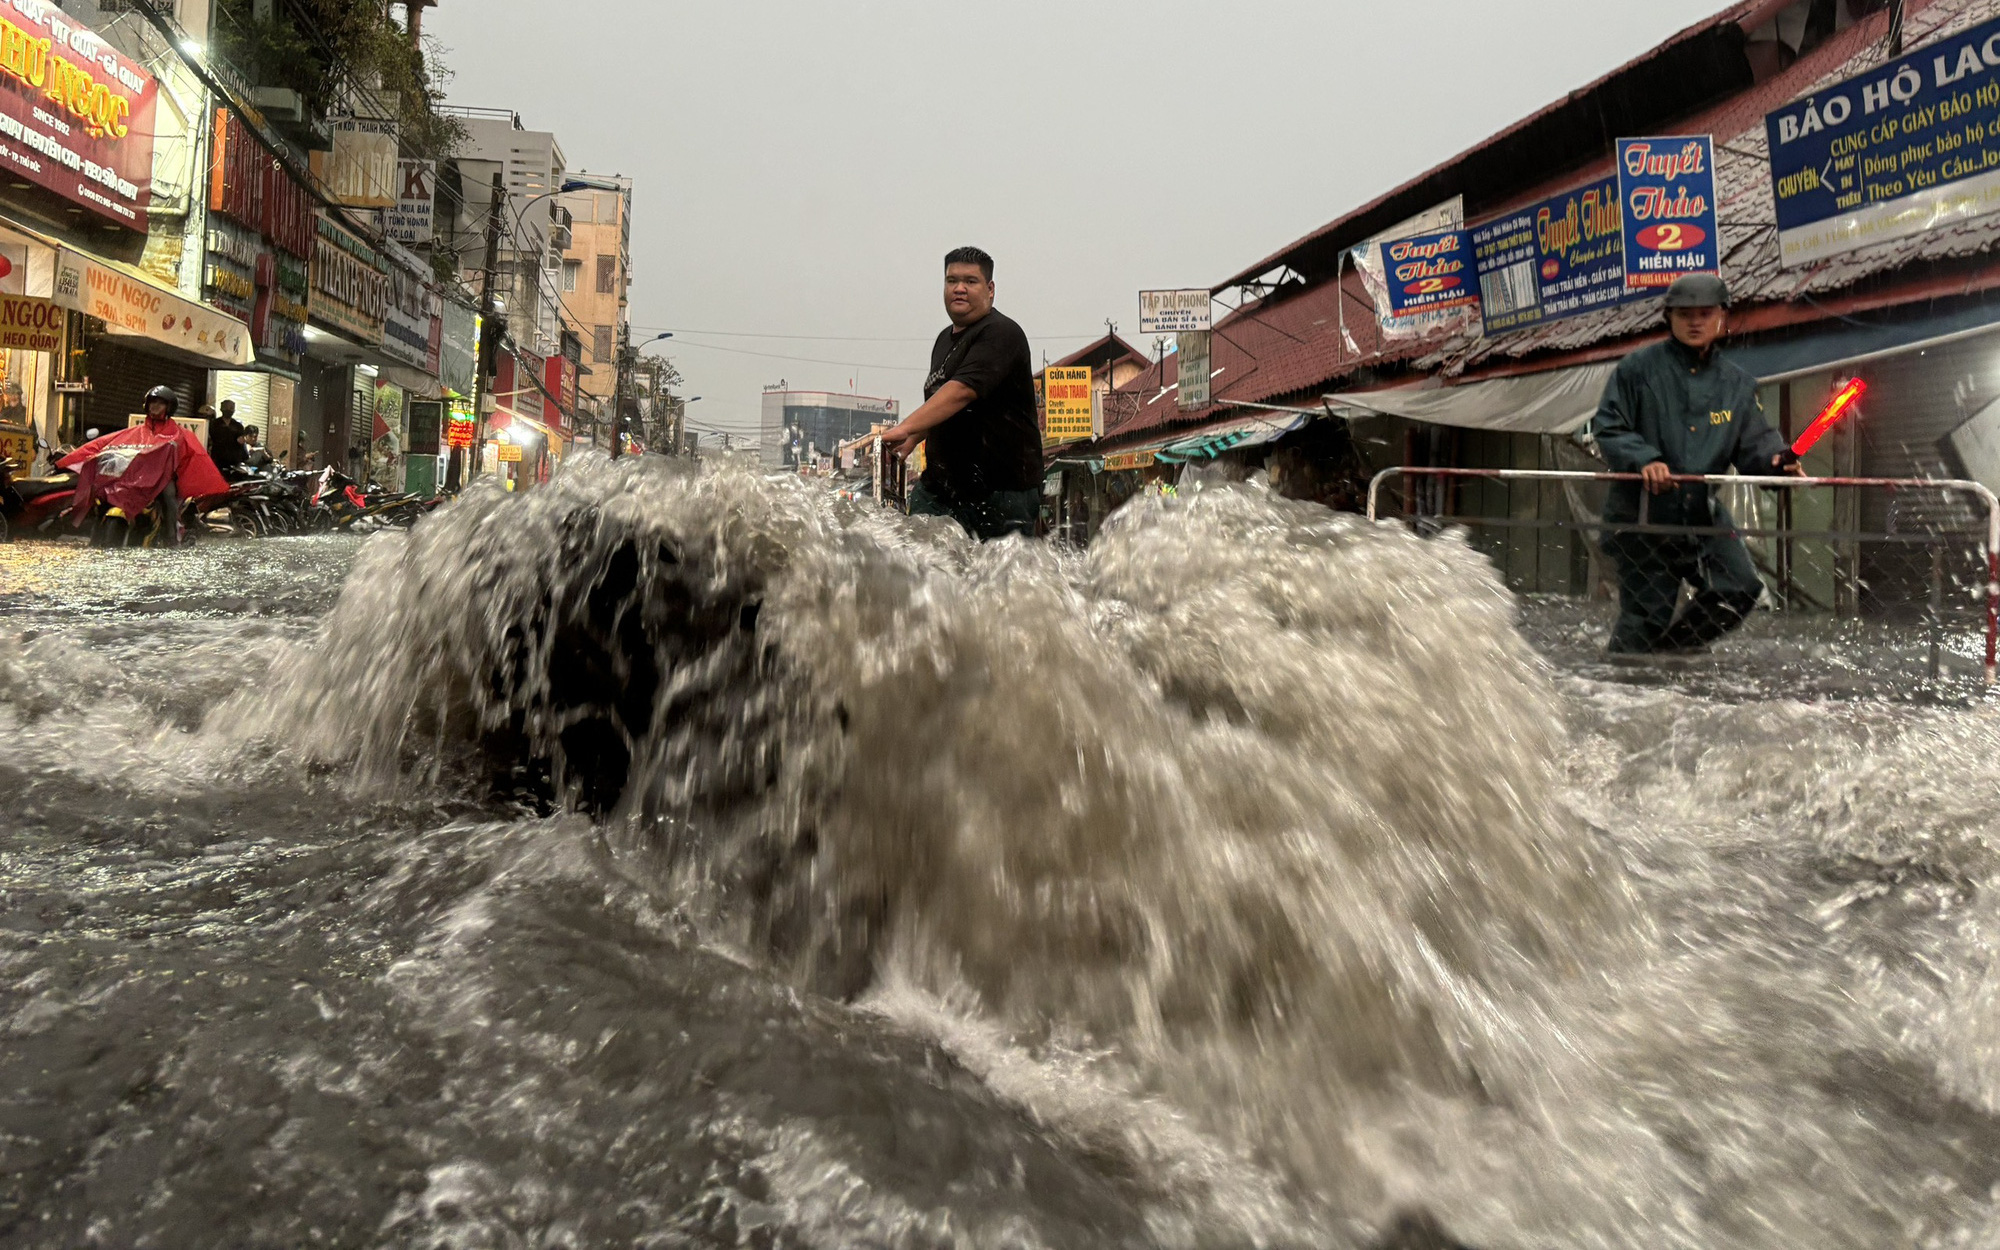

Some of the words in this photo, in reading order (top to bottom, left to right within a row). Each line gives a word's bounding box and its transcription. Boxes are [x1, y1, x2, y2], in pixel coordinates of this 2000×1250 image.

[69, 30, 98, 63] QUAY
[118, 65, 145, 95] QUAY
[1779, 97, 1852, 145] BẢO
[1862, 63, 1922, 116] HỘ
[32, 106, 55, 128] SINCE
[54, 117, 70, 137] 1992
[1831, 129, 1868, 158] CUNG
[1871, 114, 1899, 145] CẤP
[1902, 104, 1936, 134] GIÀY
[1940, 91, 1972, 121] BẢO
[1936, 131, 1963, 155] bảo
[1965, 122, 1985, 145] hộ
[1624, 141, 1704, 181] Tuyết
[1867, 180, 1903, 203] Theo
[1906, 168, 1938, 191] Yêu
[1630, 186, 1709, 220] Thảo
[1537, 196, 1581, 258] Tuyết
[1656, 223, 1683, 250] 2
[1389, 234, 1460, 261] Tuyết
[1395, 257, 1464, 282] Thảo
[1419, 277, 1444, 294] 2
[86, 266, 121, 297] NHƯ
[121, 282, 162, 315] NGỌC
[1178, 293, 1209, 309] PHONG
[1, 299, 62, 335] NGỌC
[125, 312, 148, 334] 9PM
[3, 331, 27, 346] HEO
[29, 332, 60, 350] QUAY
[1049, 367, 1065, 380] CỬA
[1066, 368, 1087, 380] HÀNG
[1048, 382, 1069, 399] HOÀNG
[1069, 384, 1088, 399] TRANG
